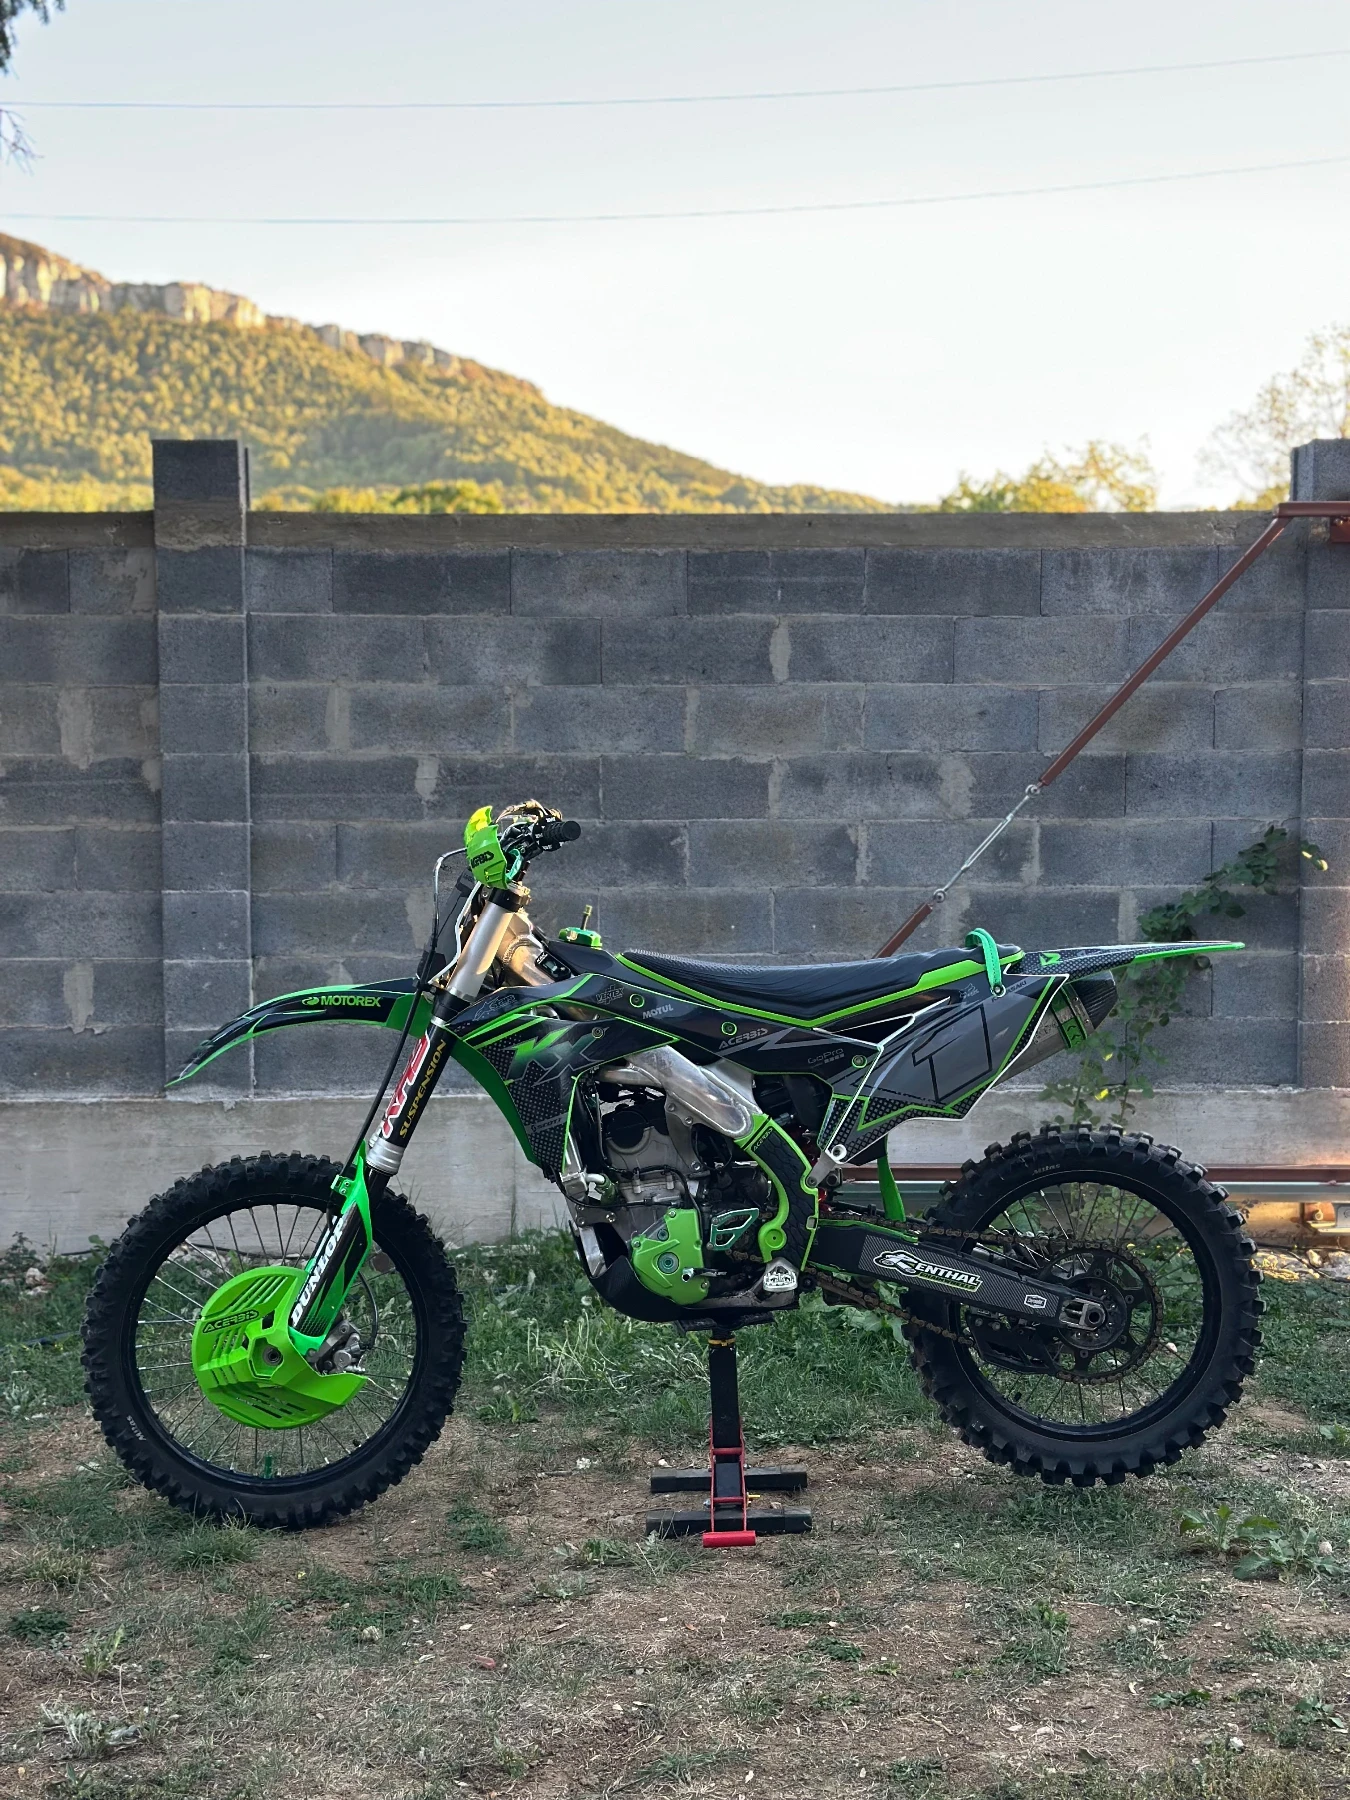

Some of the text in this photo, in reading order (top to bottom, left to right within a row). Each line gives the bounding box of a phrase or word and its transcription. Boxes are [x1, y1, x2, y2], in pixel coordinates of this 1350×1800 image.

[320, 995, 382, 1007] MOTOREX
[642, 1004, 674, 1020] MOTUL
[718, 1027, 768, 1050] ACERBIS
[807, 1048, 844, 1064] GoPro
[399, 1039, 447, 1139] SUSPENSION
[291, 1217, 344, 1328] DUNLOP
[203, 1310, 259, 1334] ACERBIS
